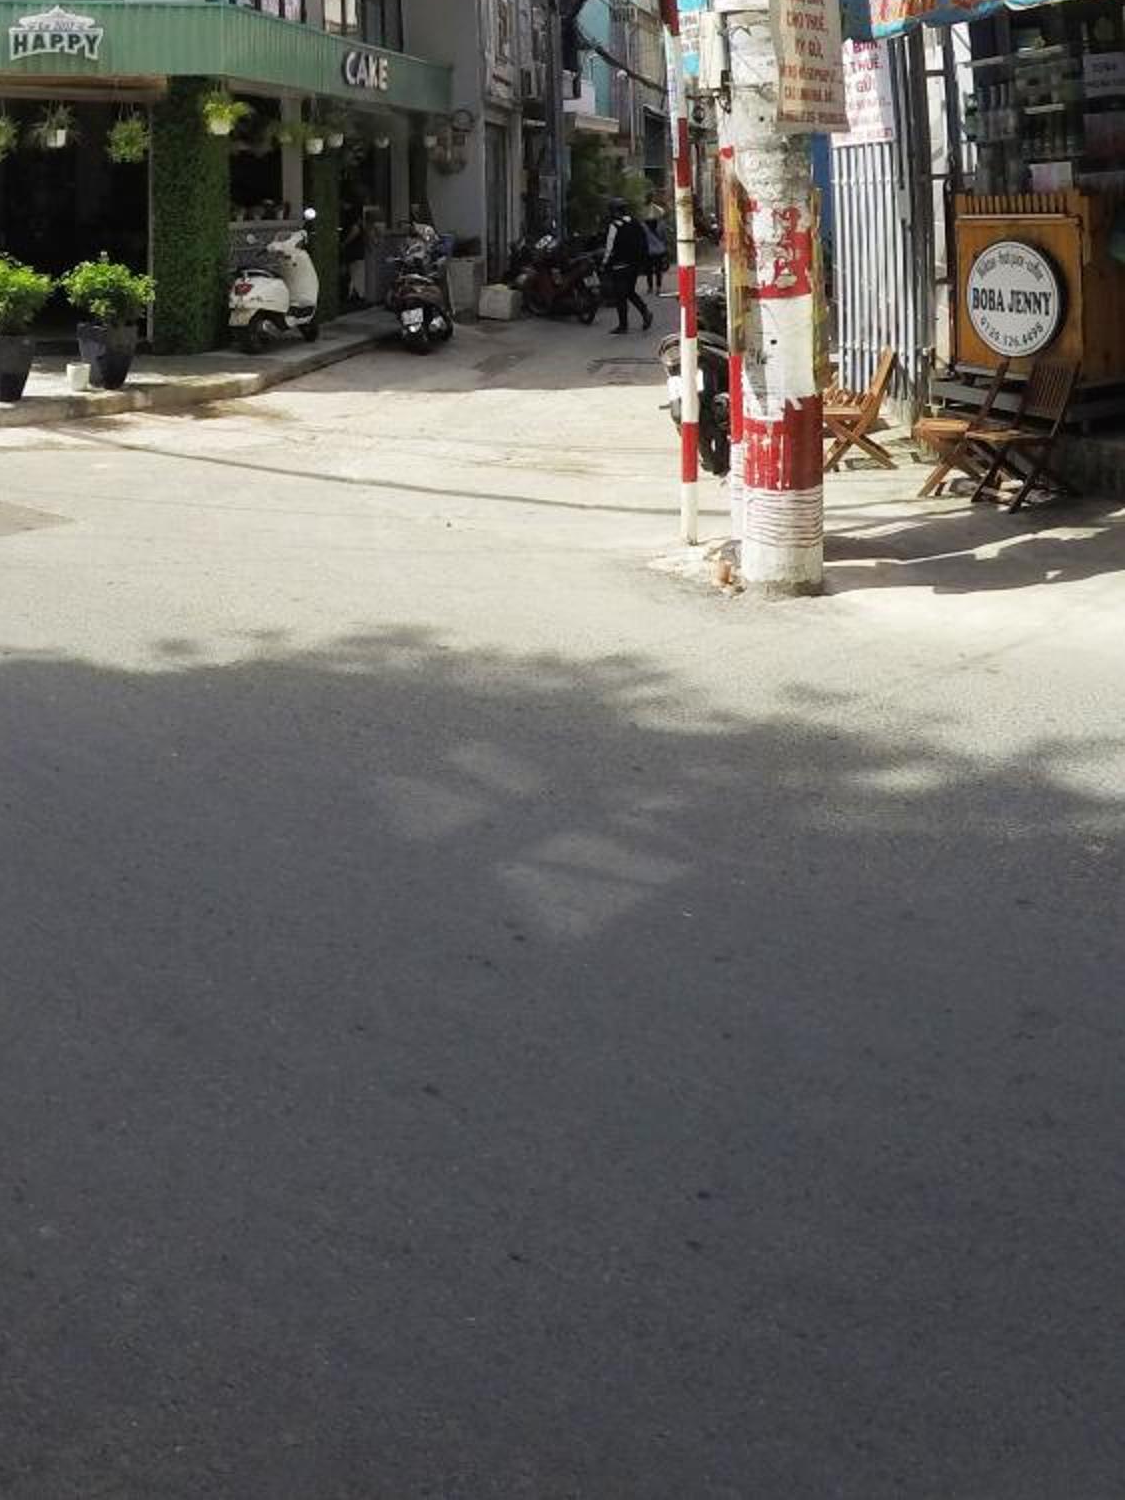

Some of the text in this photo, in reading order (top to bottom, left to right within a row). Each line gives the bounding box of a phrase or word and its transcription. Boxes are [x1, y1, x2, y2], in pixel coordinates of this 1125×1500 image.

[14, 33, 98, 55] HAPPY
[346, 51, 388, 91] CAKE
[972, 287, 1051, 316] BOBA JENNY
